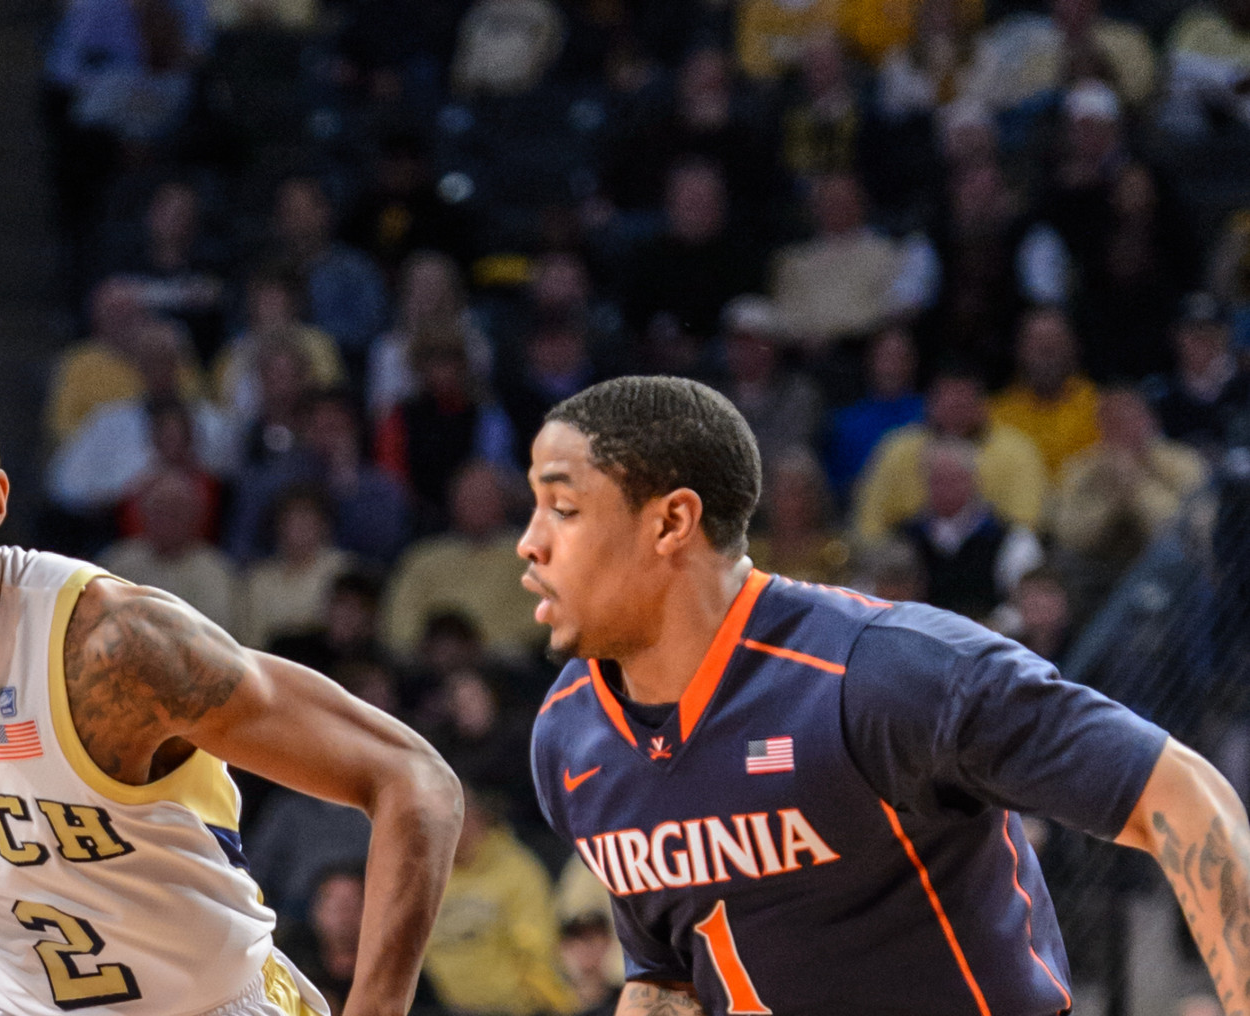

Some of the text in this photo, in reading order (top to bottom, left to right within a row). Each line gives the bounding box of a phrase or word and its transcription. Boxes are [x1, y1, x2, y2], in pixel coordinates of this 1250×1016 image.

[575, 807, 841, 897] VIRGINIA
[11, 899, 143, 1011] 2
[694, 899, 773, 1016] 1
